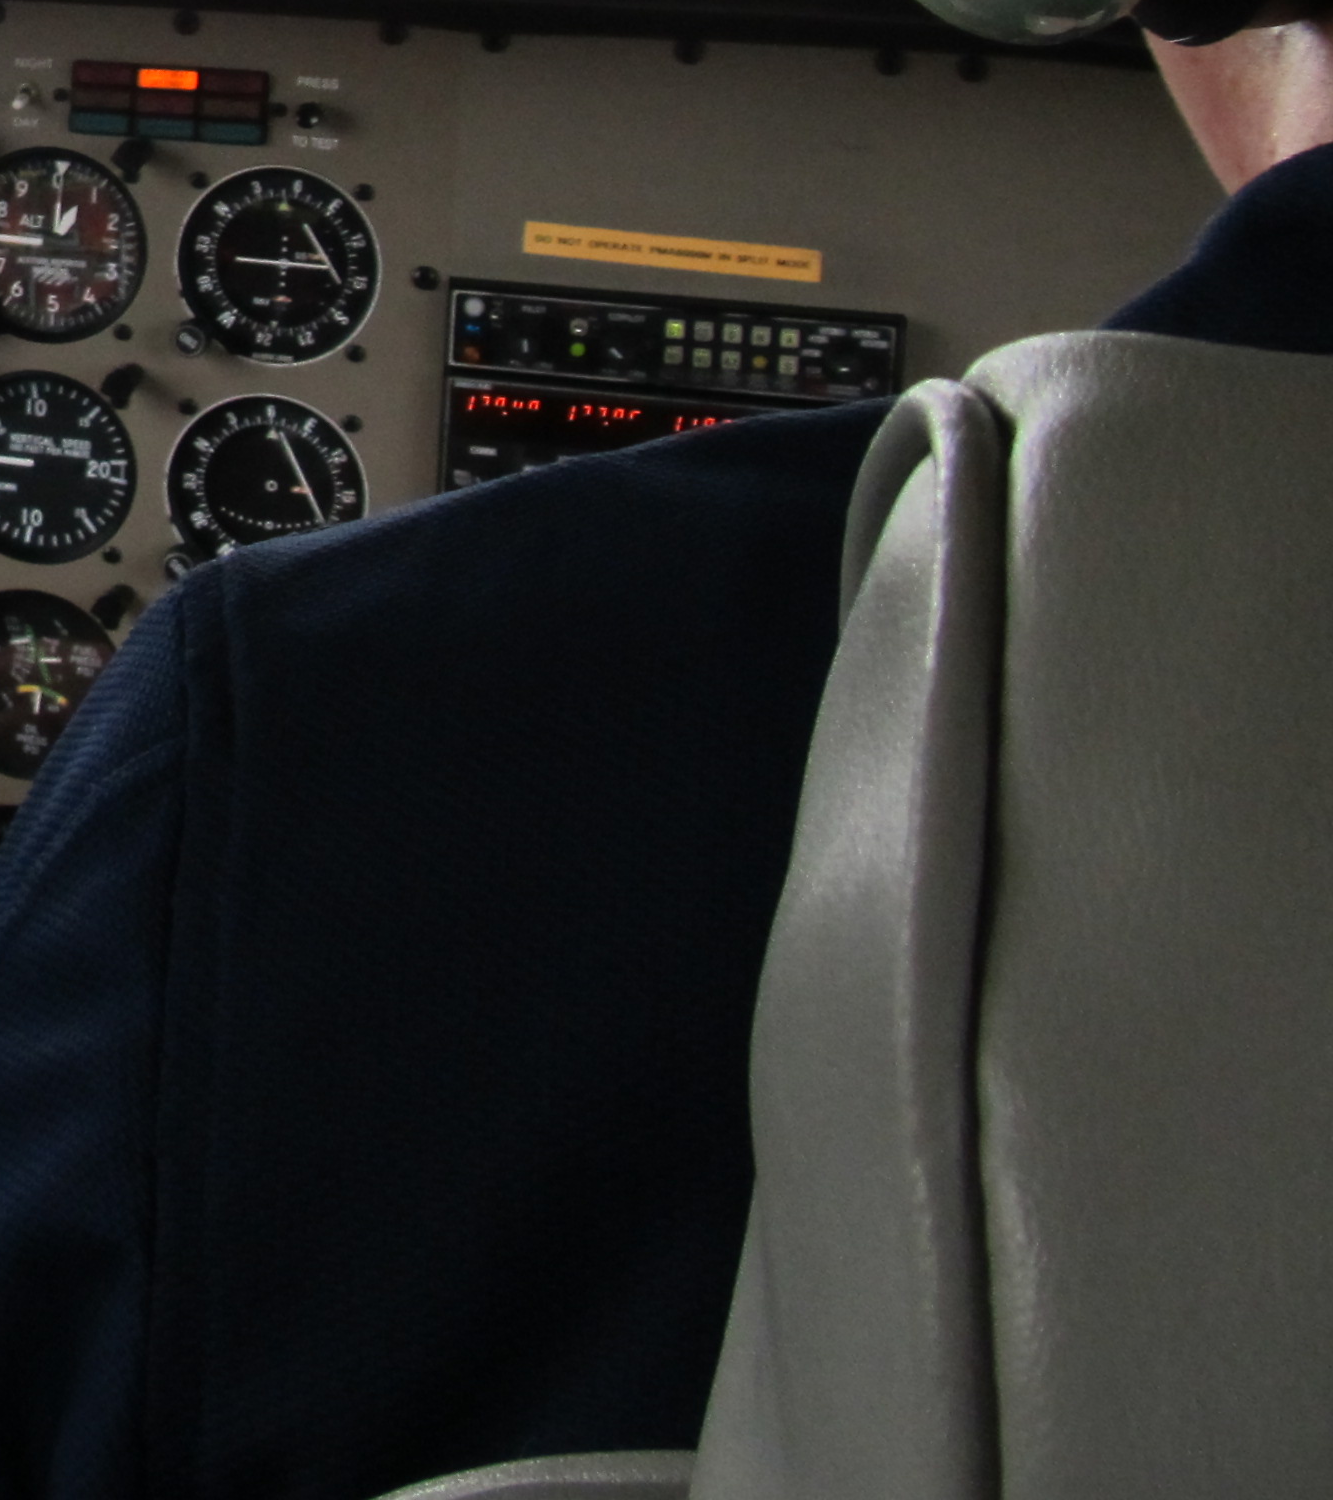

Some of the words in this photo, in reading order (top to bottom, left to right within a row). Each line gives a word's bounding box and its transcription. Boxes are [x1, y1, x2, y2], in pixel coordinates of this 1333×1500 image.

[311, 137, 340, 150] TEST
[15, 180, 29, 198] 9
[19, 213, 45, 229] ALT
[106, 213, 120, 231] 2
[105, 262, 118, 281] 3
[10, 280, 24, 298] 6
[83, 286, 96, 304] 4
[47, 294, 60, 313] 5
[25, 399, 48, 418] 10
[61, 438, 93, 451] SPEED
[86, 460, 111, 478] 20
[20, 507, 44, 527] 10
